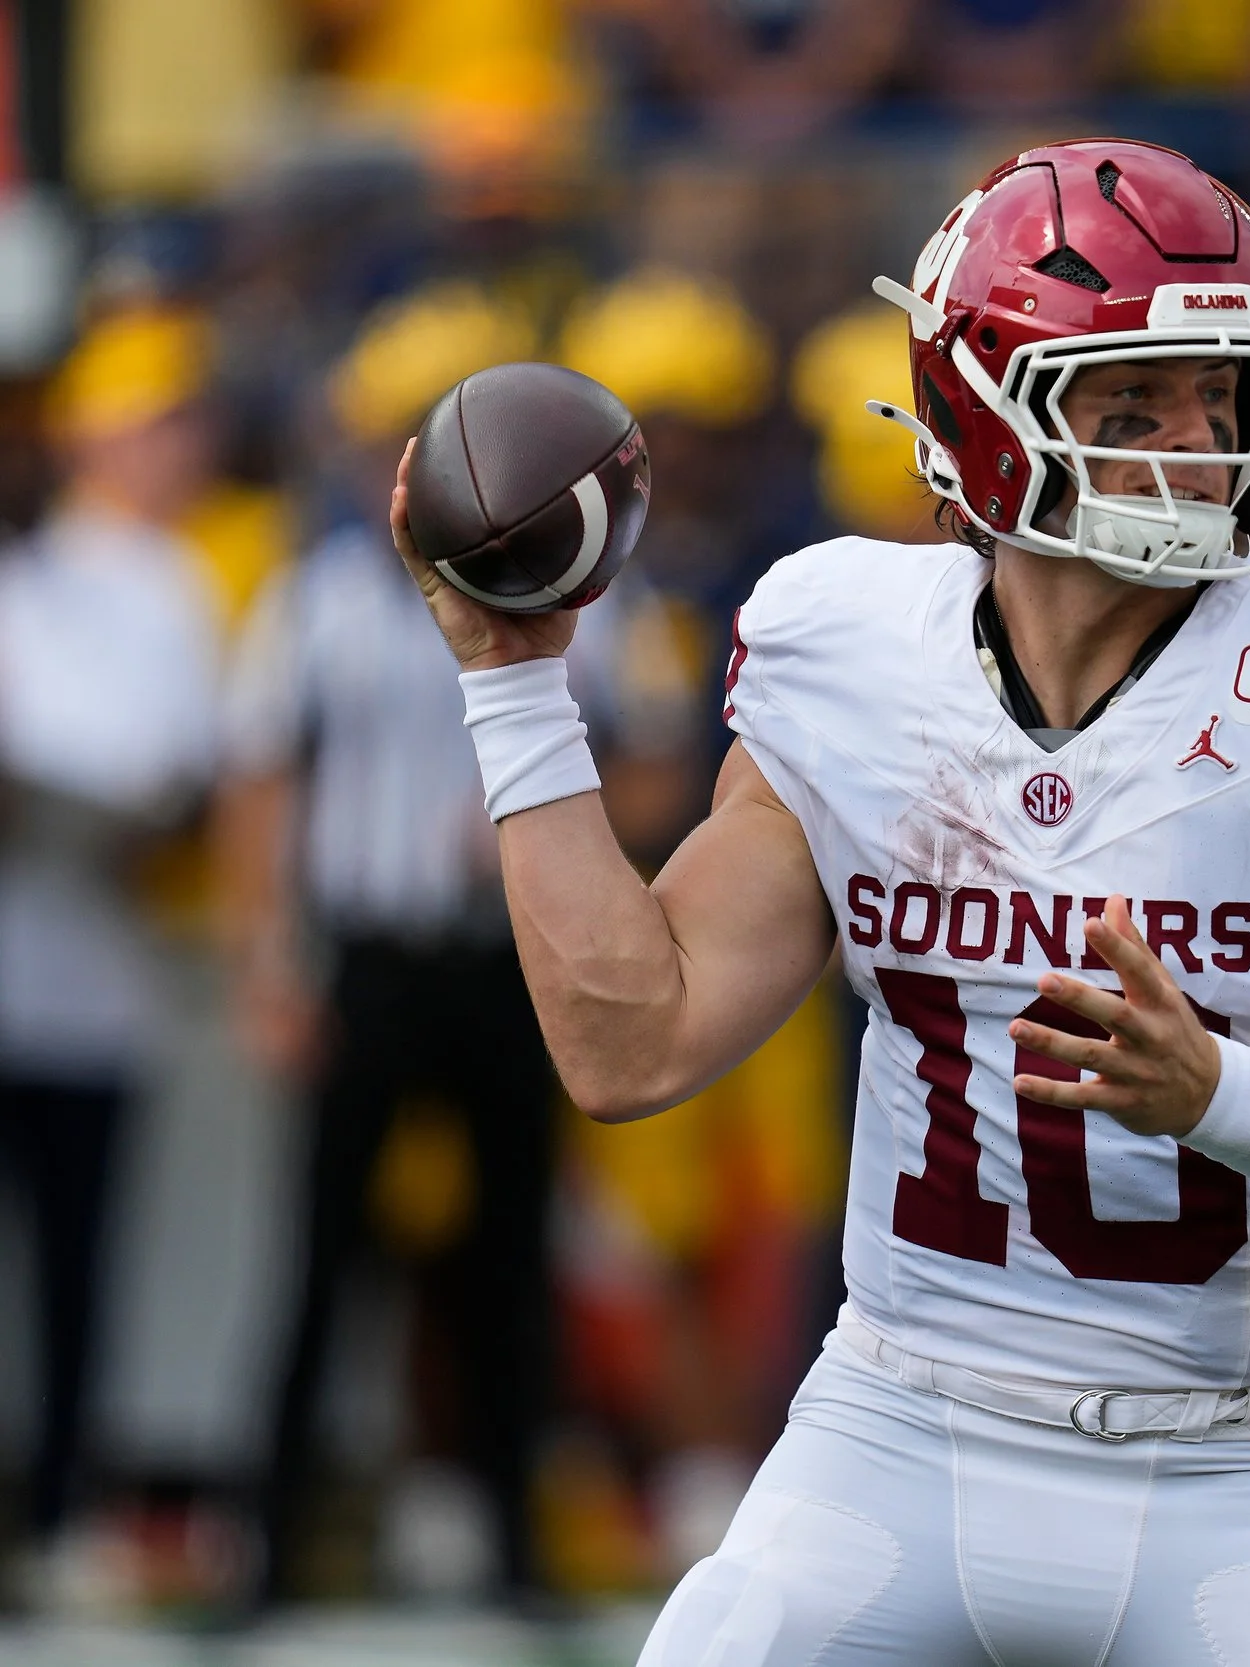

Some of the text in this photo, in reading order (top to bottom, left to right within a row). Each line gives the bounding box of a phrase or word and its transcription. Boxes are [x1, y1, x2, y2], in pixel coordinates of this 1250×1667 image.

[1183, 294, 1248, 309] OKLAHOMA
[1025, 775, 1069, 822] SEC
[873, 967, 1249, 1285] 10
